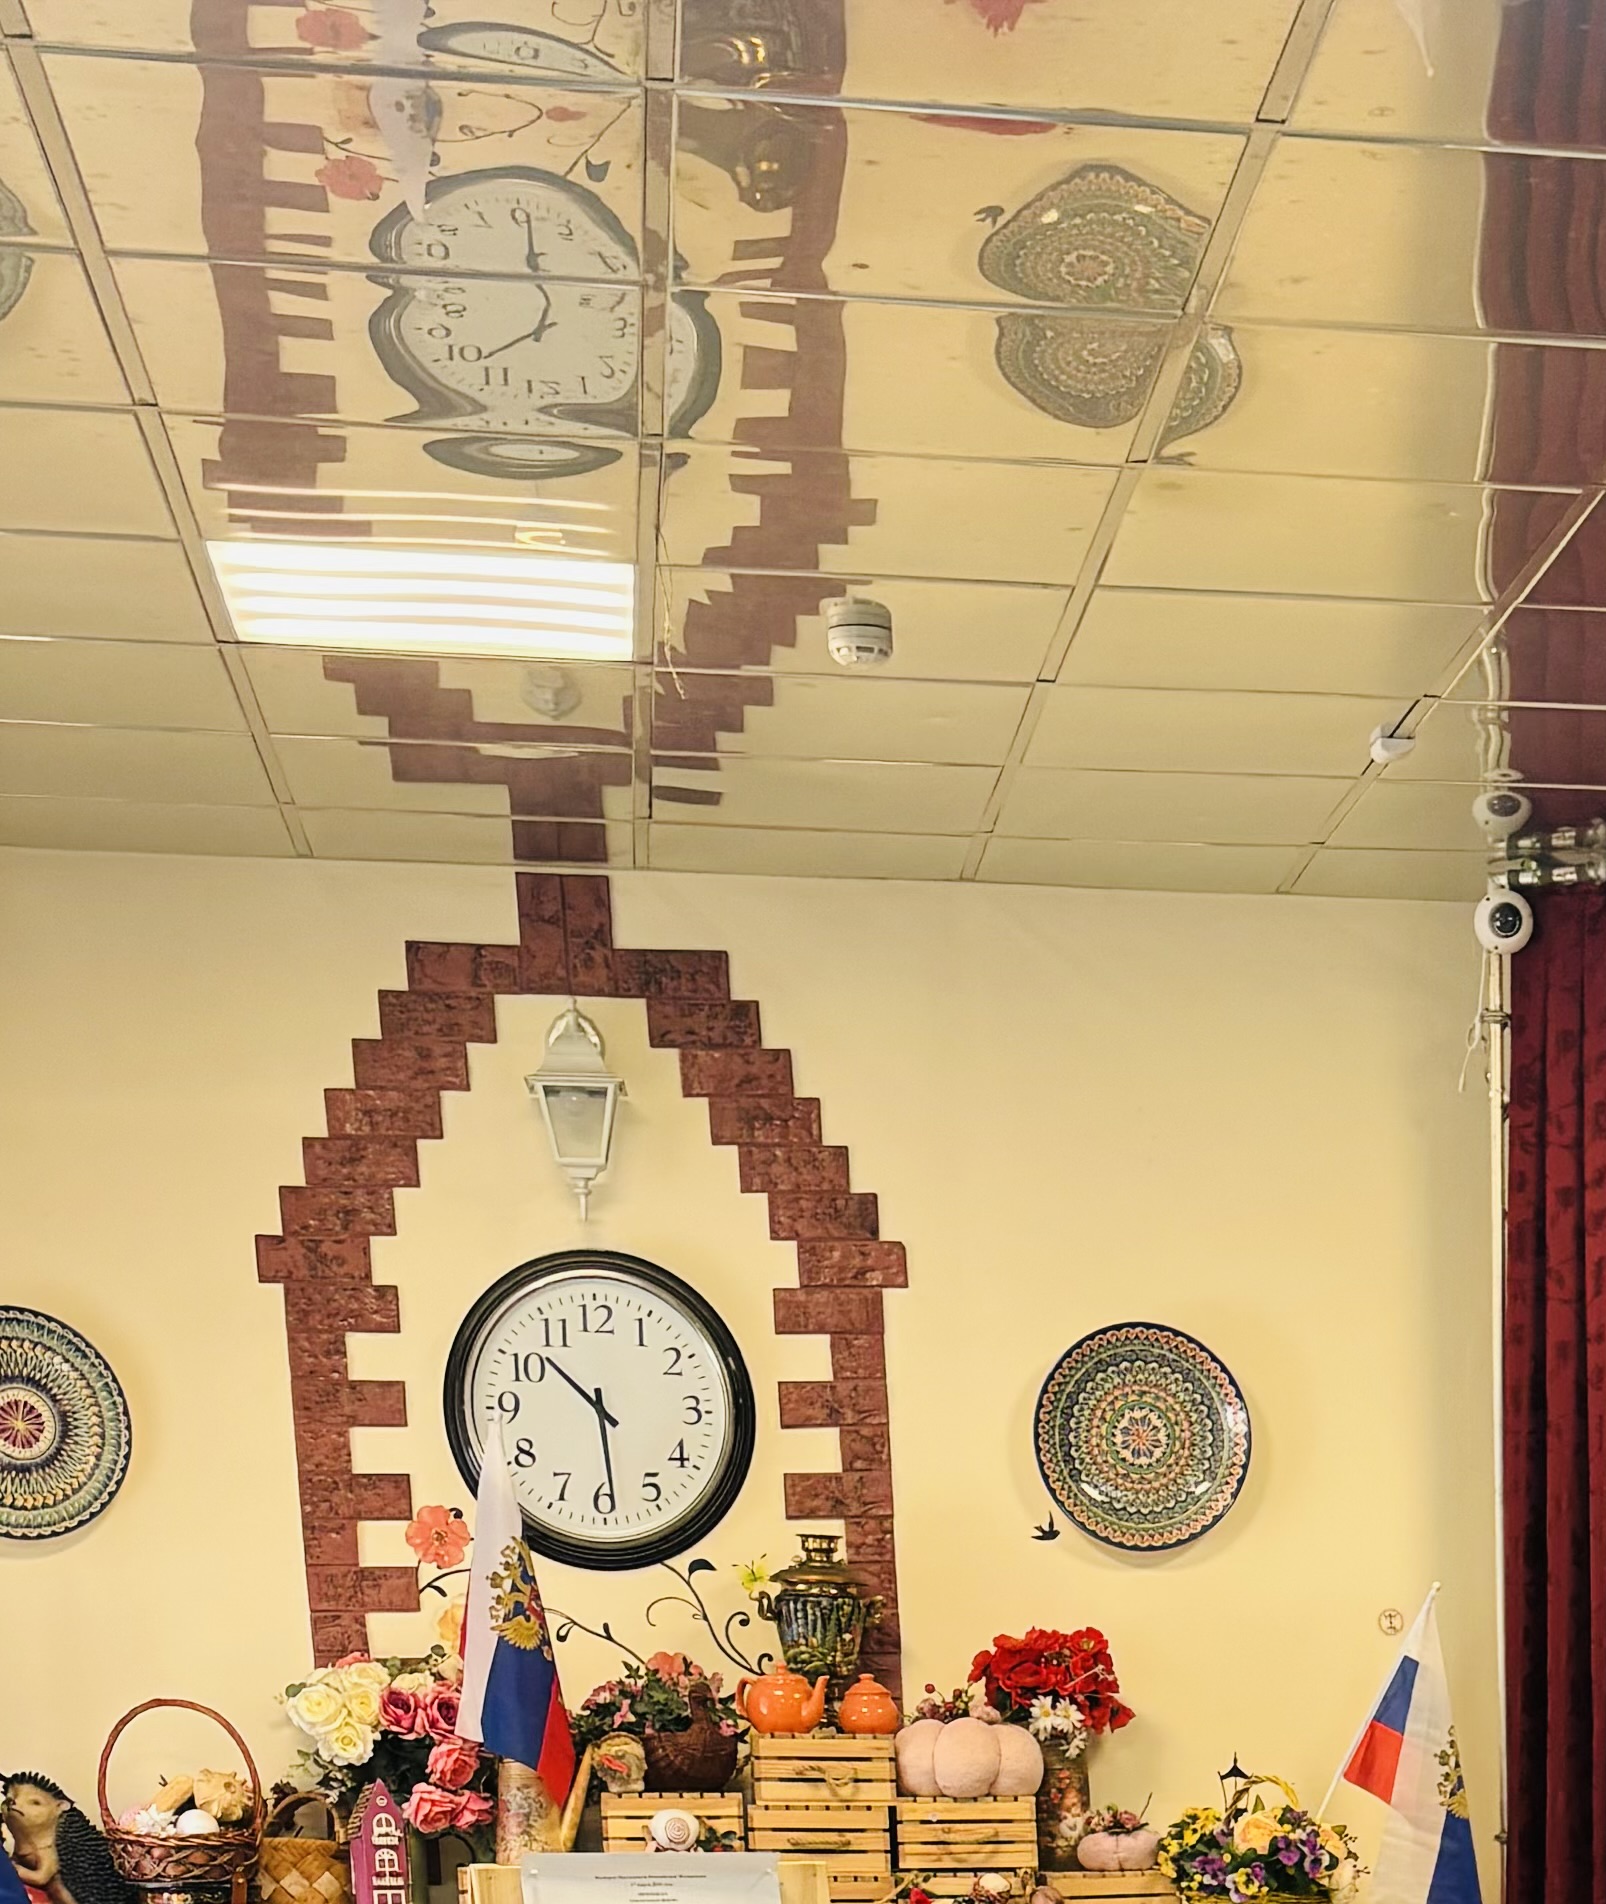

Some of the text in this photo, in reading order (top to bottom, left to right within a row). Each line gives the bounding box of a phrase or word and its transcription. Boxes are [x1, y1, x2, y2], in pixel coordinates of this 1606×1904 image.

[541, 1318, 571, 1348] 11
[578, 1303, 615, 1335] 12
[634, 1317, 648, 1348] 1
[512, 1352, 546, 1383] 10
[662, 1347, 683, 1377] 2
[498, 1391, 520, 1424] 9
[682, 1395, 702, 1425] 3
[514, 1438, 537, 1468] 8
[668, 1438, 690, 1469] 4
[552, 1471, 571, 1502] 7
[593, 1481, 616, 1514] 6
[642, 1472, 661, 1502] 5
